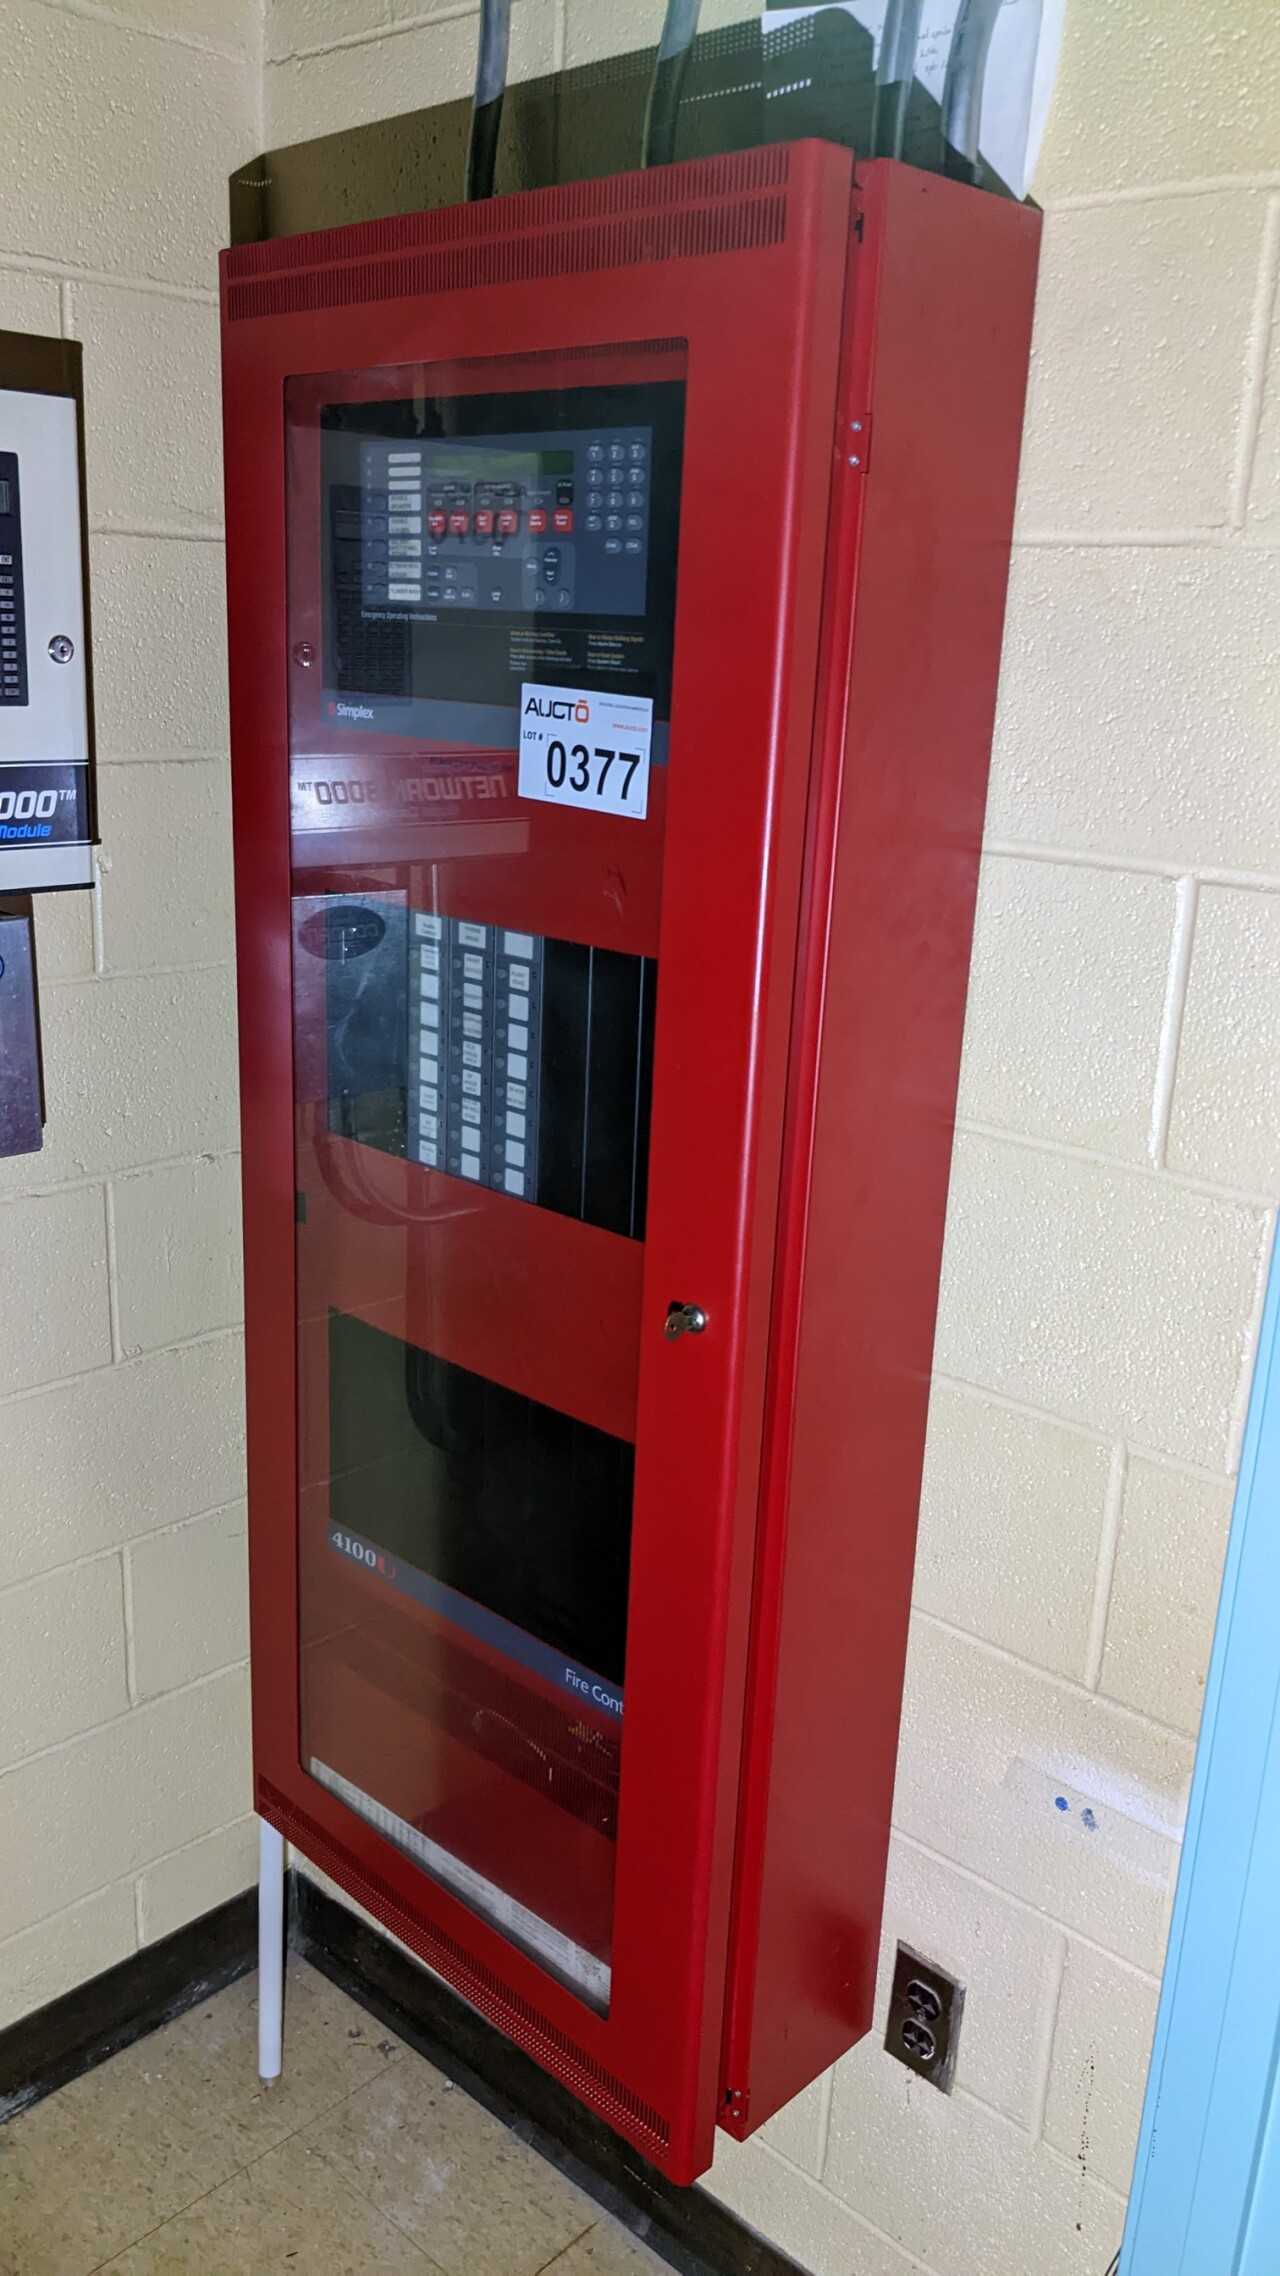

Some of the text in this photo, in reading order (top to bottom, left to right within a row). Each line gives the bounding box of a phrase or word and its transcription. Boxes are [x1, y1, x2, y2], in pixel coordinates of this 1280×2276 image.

[336, 702, 374, 721] Simplex
[523, 730, 537, 741] LOT
[546, 740, 641, 801] 0377
[565, 1667, 589, 1694] Fire
